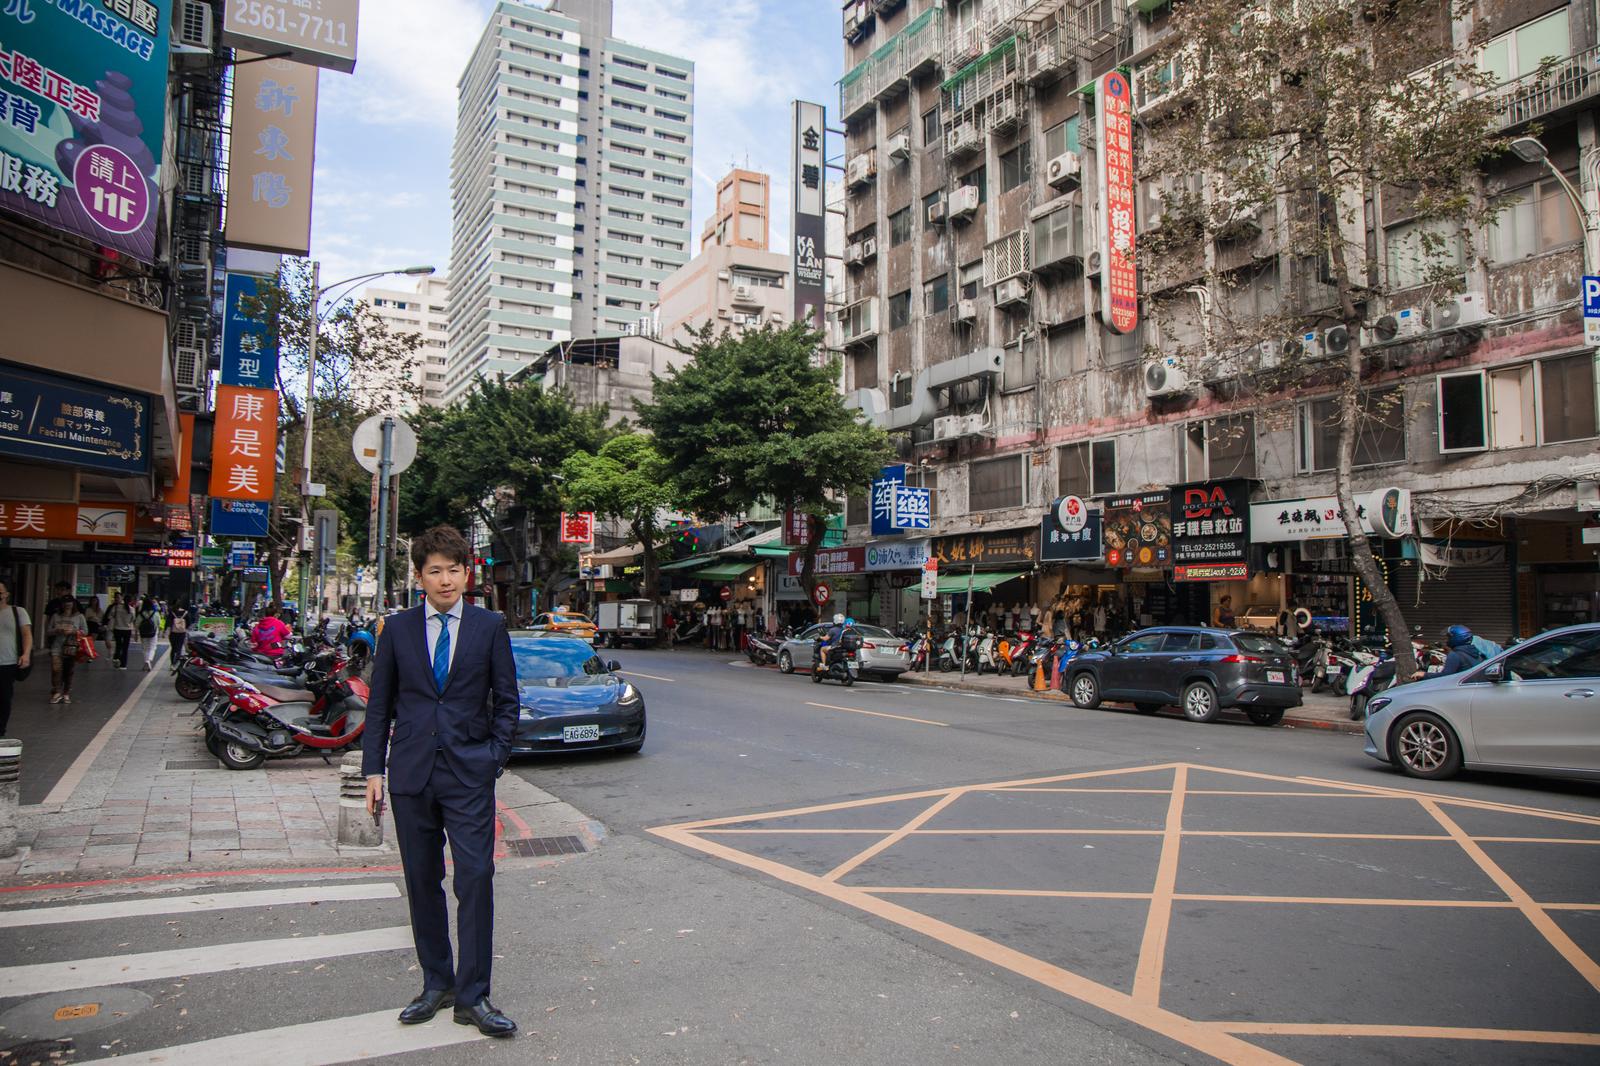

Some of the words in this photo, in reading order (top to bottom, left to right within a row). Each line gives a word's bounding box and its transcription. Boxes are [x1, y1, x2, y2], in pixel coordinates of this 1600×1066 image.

[58, 0, 153, 61] MASSAGE
[234, 0, 348, 47] 2561-7711
[90, 151, 136, 193] 請上
[90, 186, 136, 223] 11F
[39, 426, 67, 439] Facial
[69, 431, 122, 448] Maintenance
[228, 392, 265, 494] 康是美
[0, 503, 46, 532] 美
[897, 488, 929, 528] 藥
[1173, 517, 1243, 538] 手機急救站
